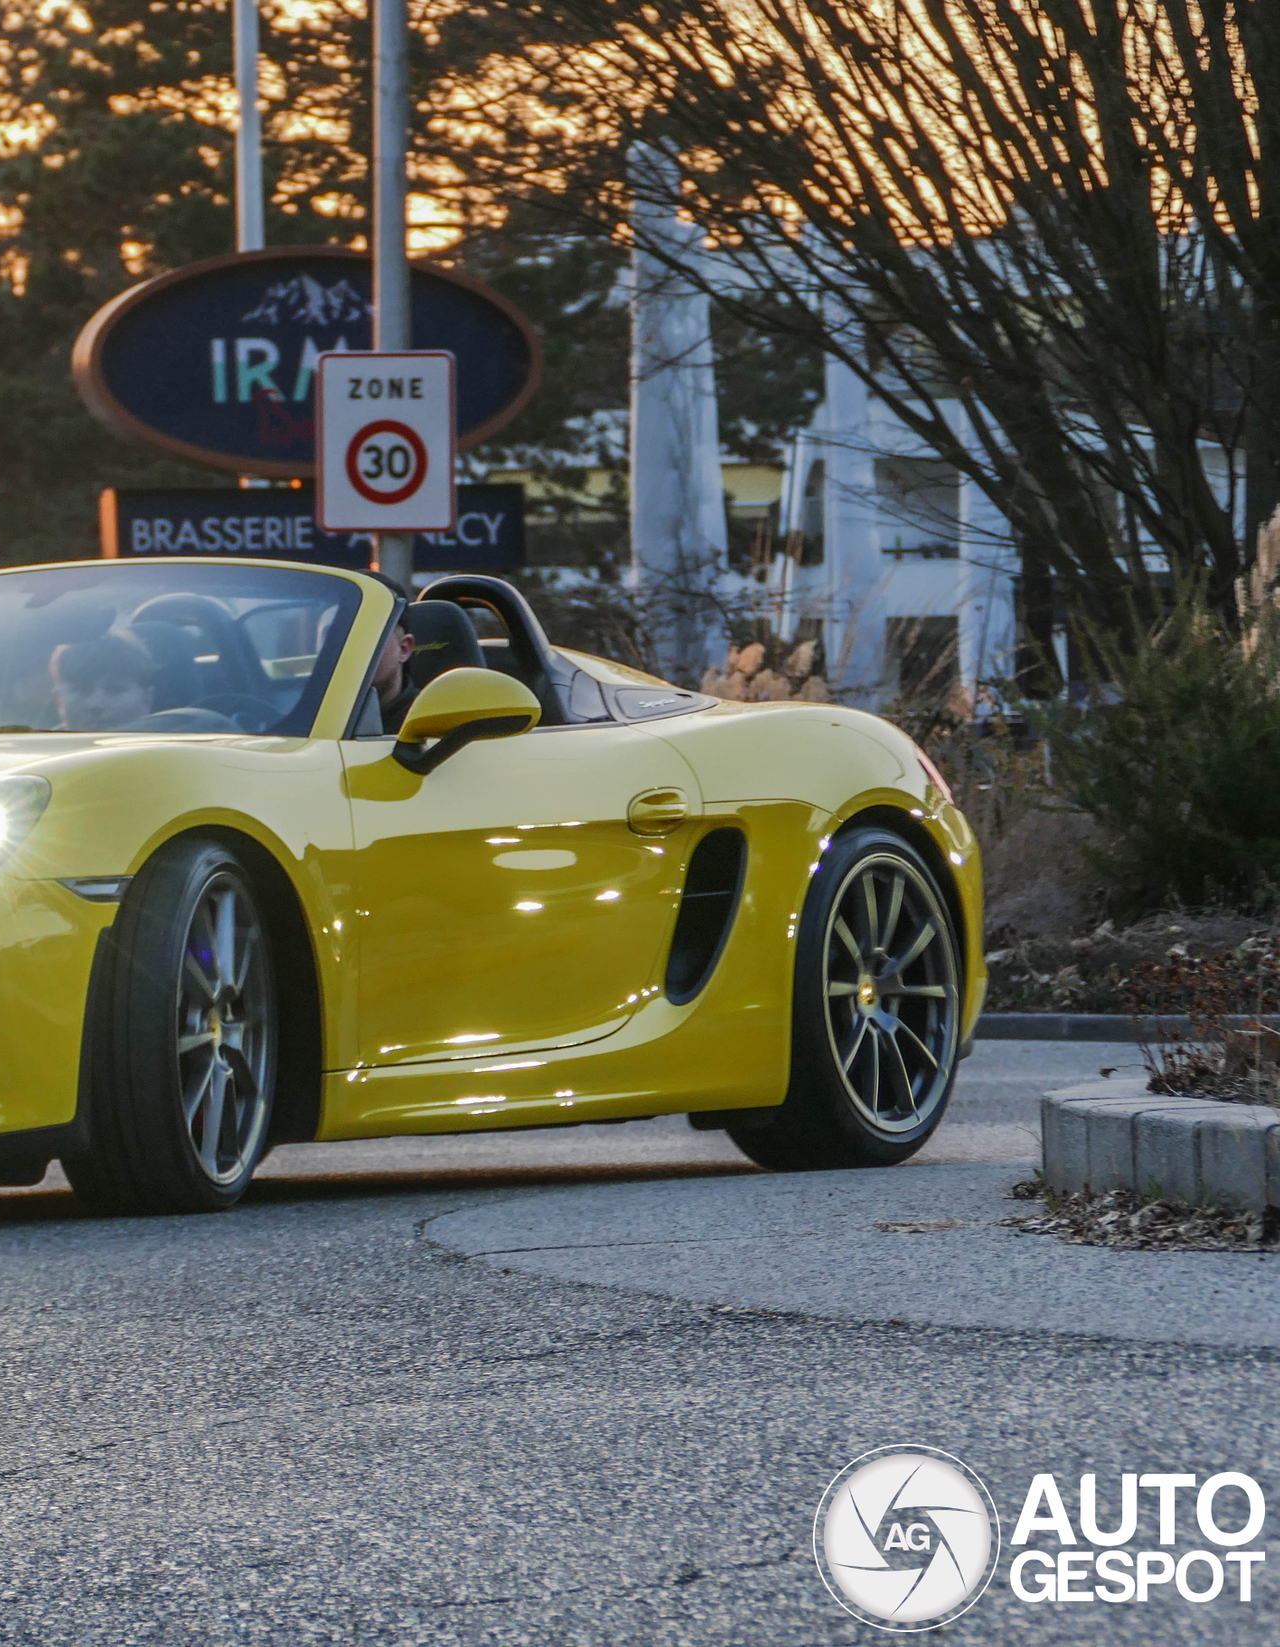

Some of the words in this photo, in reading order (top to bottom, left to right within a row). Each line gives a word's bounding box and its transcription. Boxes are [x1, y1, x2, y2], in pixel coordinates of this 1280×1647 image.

[348, 378, 424, 400] ZONE
[363, 445, 410, 479] 30
[132, 517, 314, 551] BRASSERIE
